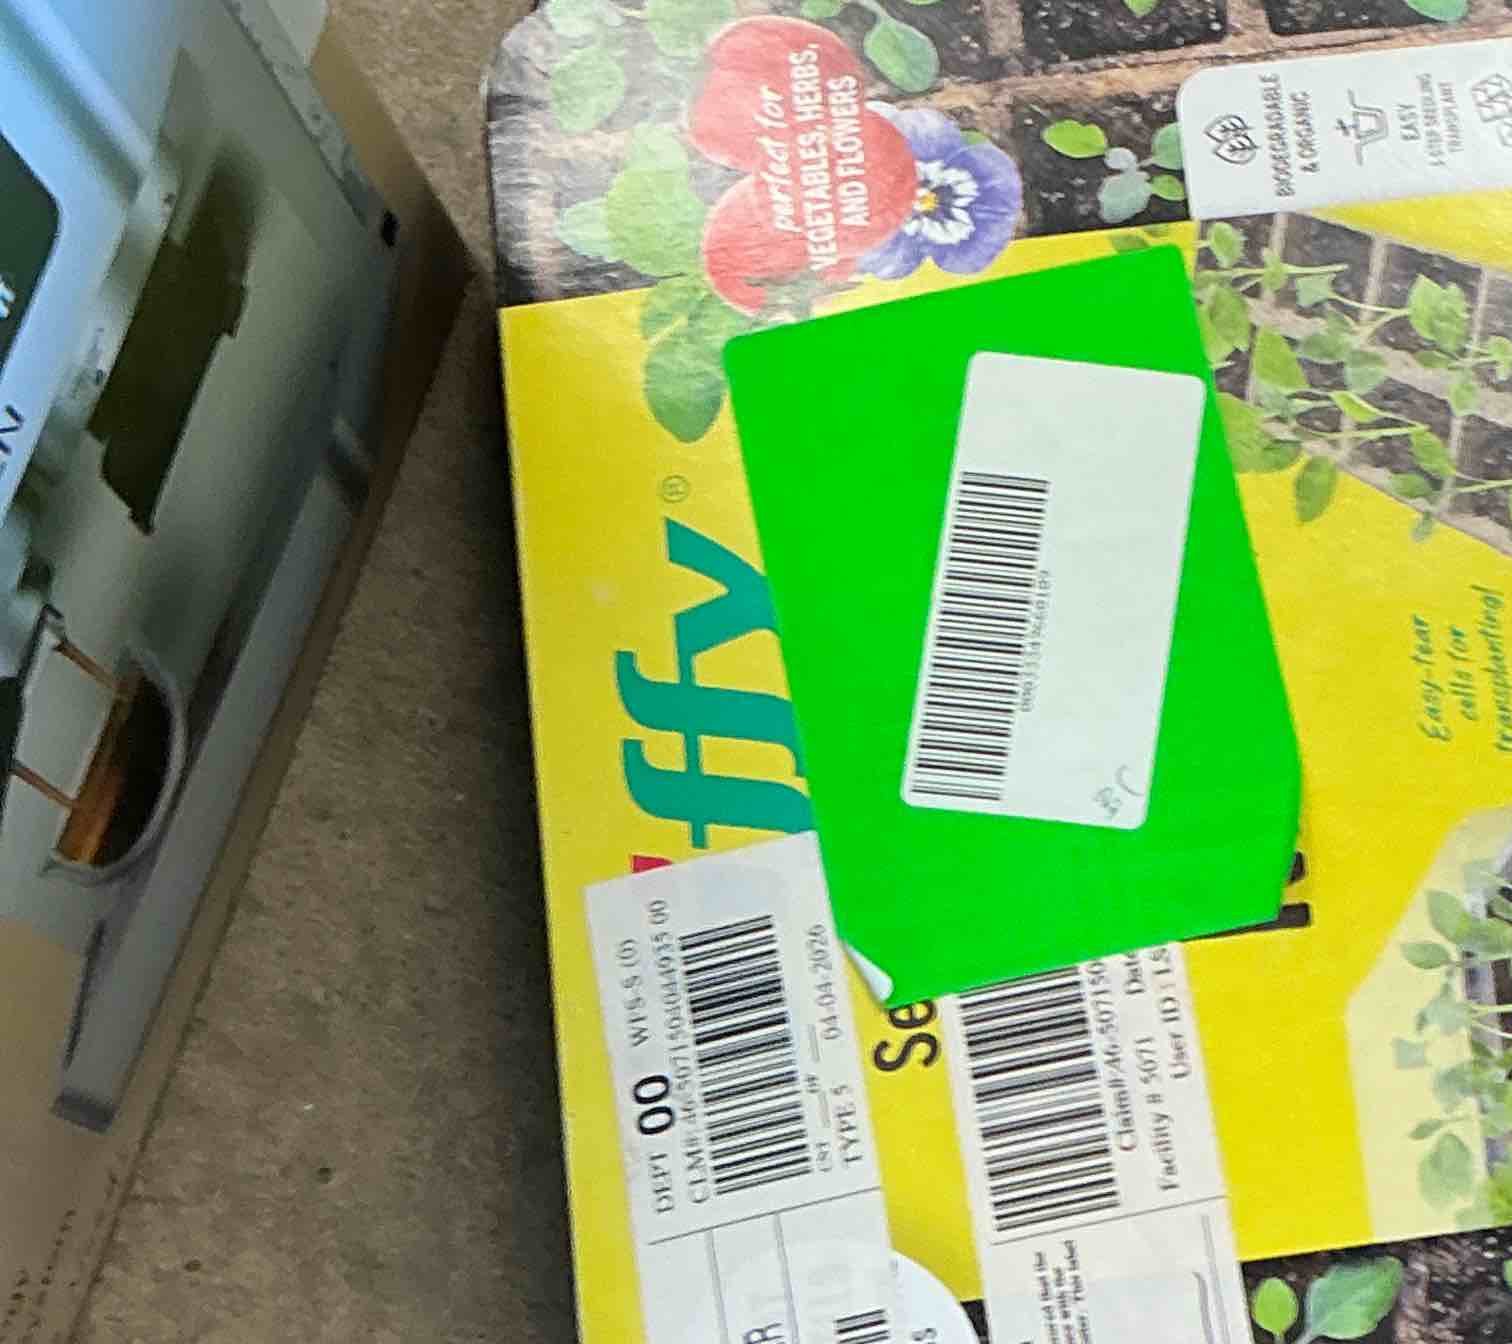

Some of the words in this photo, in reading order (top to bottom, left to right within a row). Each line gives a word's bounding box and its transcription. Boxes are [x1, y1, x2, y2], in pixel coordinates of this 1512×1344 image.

[750, 82, 789, 130] for
[787, 42, 827, 122] HERBS,
[825, 73, 866, 177] FLOWERS
[1257, 70, 1296, 198] BIODEGRADABLE
[1288, 89, 1318, 160] ORGANIC
[1396, 100, 1421, 142] EASY
[1438, 79, 1464, 153] TRANSPLANT
[754, 133, 803, 235] perfect
[795, 123, 840, 271] VEGETABLES,
[836, 179, 871, 228] AND
[1443, 622, 1476, 664] for
[1406, 611, 1452, 744] Easy-tear
[1448, 668, 1478, 722] cells
[1159, 995, 1180, 1024] ID
[1135, 1034, 1161, 1085] 5071
[1164, 1029, 1191, 1079] User
[627, 1071, 679, 1138] 00
[1144, 1091, 1162, 1105] #
[644, 1150, 679, 1214] DEPT
[1146, 1110, 1183, 1191] Facility
